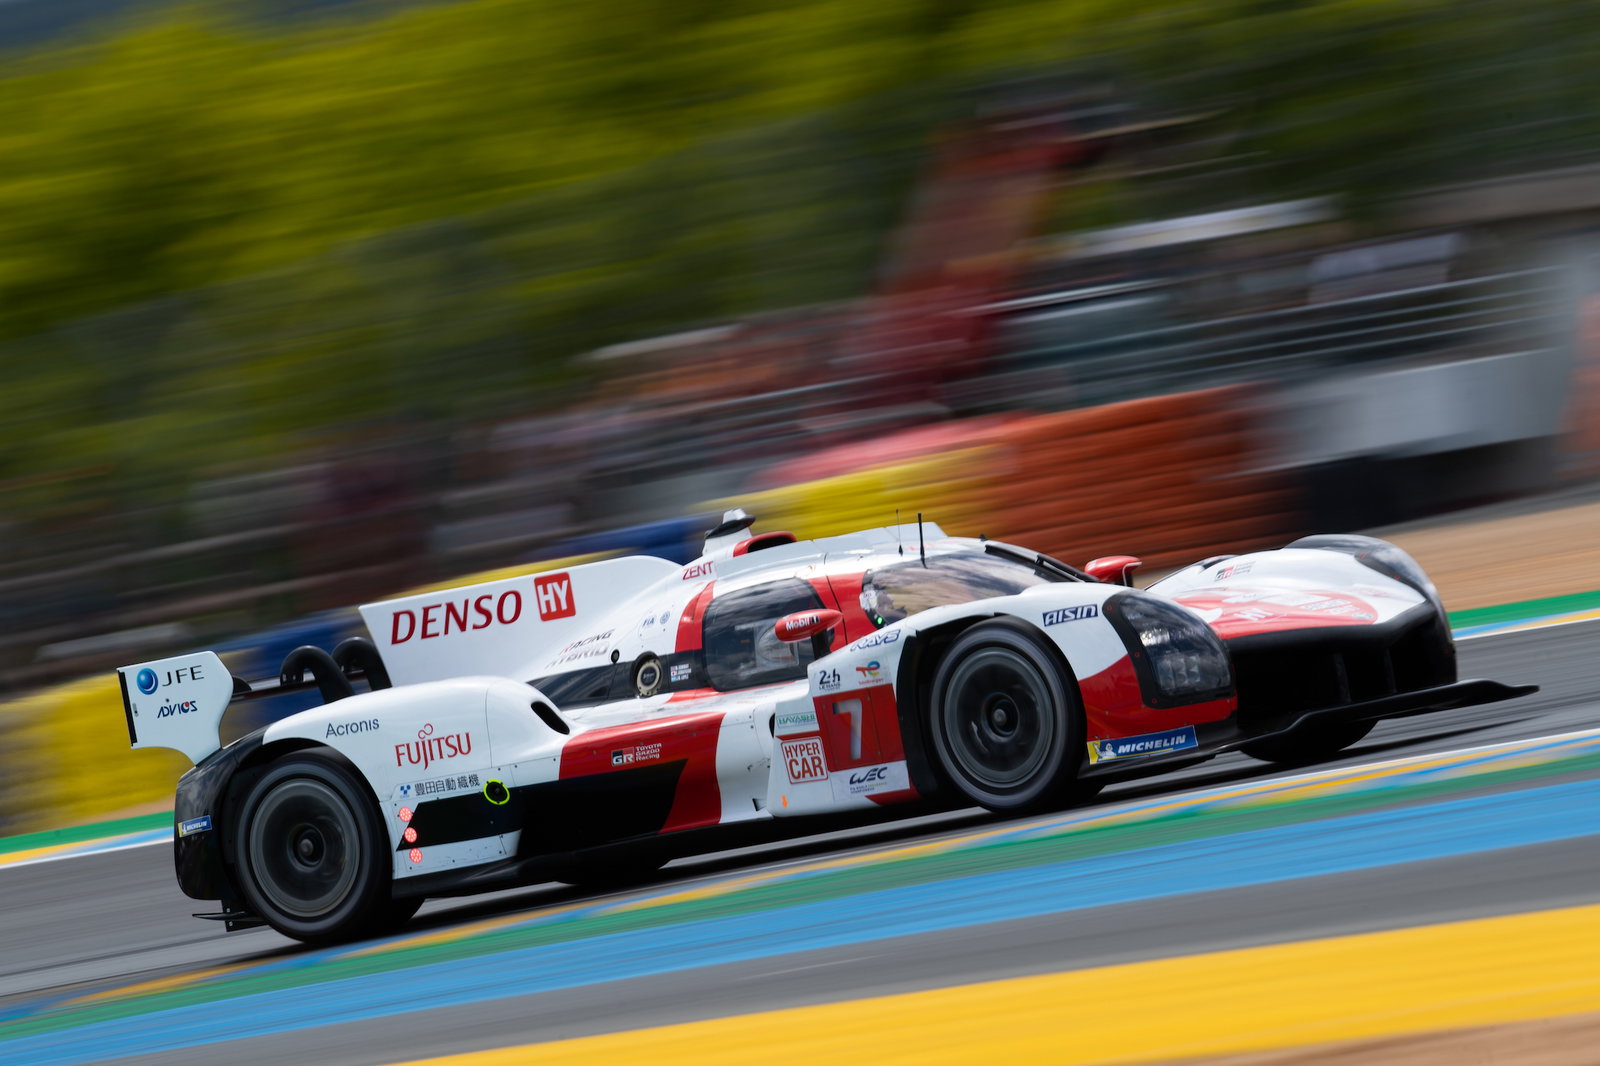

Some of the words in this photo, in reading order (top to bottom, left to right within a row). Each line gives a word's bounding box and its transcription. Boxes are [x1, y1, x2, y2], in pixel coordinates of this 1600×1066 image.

[682, 561, 713, 581] ZENT
[537, 580, 568, 615] HY
[391, 590, 522, 645] DENSO
[785, 617, 810, 631] Mobil
[1044, 605, 1097, 627] AISIN
[162, 665, 204, 687] JFE
[157, 701, 198, 719] ADVICS
[778, 714, 816, 725] HAYASHI
[325, 718, 380, 739] Acronis
[832, 698, 863, 760] 7
[394, 731, 472, 770] FUJITSU
[636, 743, 662, 751] TOYOTA
[784, 742, 820, 759] HYPER
[1118, 735, 1187, 754] MICHELIN
[613, 754, 634, 765] GR
[636, 753, 660, 761] Racing
[789, 756, 824, 779] CAR
[849, 767, 888, 785] WEC
